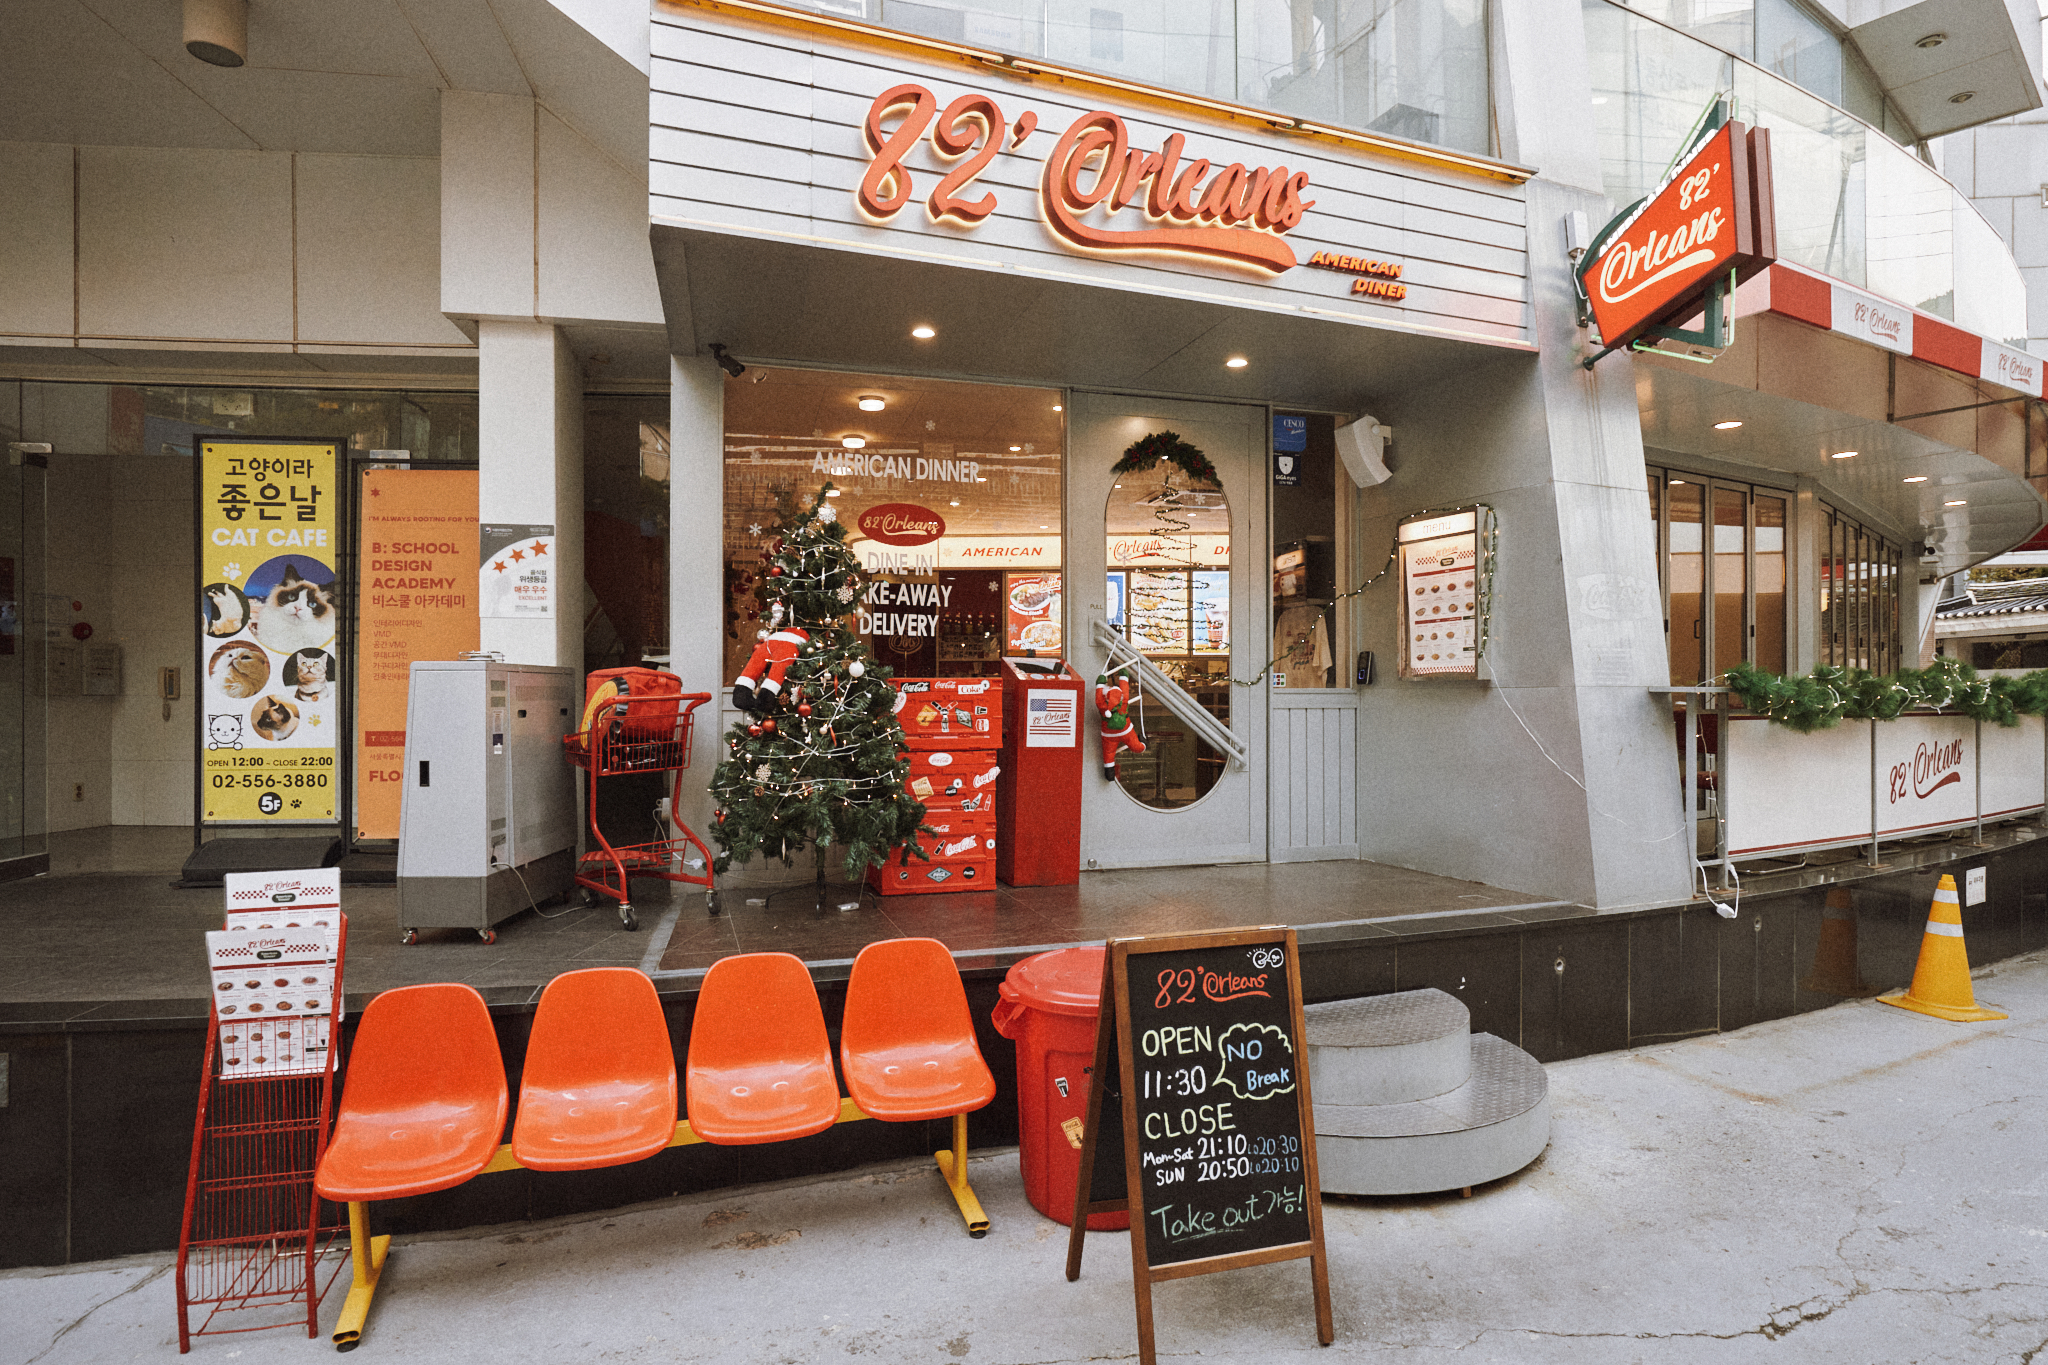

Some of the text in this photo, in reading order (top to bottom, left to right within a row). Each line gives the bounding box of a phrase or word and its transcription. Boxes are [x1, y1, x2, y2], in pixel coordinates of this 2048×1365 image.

[860, 83, 1317, 274] 82' Orleans
[1679, 163, 1720, 210] 82'
[1310, 251, 1403, 280] AMERICAN
[1600, 207, 1725, 303] Orleans
[1351, 278, 1407, 301] DINER
[1854, 302, 1901, 342] 82' Orleans
[1999, 353, 2033, 385] 82' Orleans
[1283, 419, 1305, 428] CESCO
[225, 457, 314, 481] 고양이라
[812, 451, 980, 484] AMERICAN DINNER
[217, 483, 321, 522] 좋은날
[863, 513, 940, 536] 82' Orleans
[1423, 520, 1451, 534] menu
[211, 528, 327, 547] CAT CAFE
[391, 543, 459, 554] SCHOOL
[962, 547, 1042, 557] AMERICAN
[1113, 540, 1162, 561] Orleans
[372, 560, 432, 571] DESIGN
[867, 551, 933, 577] DINE-IN
[372, 578, 456, 589] ACADEMY
[514, 586, 547, 594] 매우 우수
[860, 582, 952, 607] KE-AWAY
[372, 594, 465, 608] 비스쿨 아카데미
[373, 630, 392, 638] VMD
[860, 612, 939, 637] DELIVERY
[389, 641, 407, 649] VMD
[961, 685, 981, 693] Coke
[1044, 713, 1070, 725] Orleans
[207, 759, 229, 767] OPEN
[232, 757, 264, 767] 12:00
[273, 759, 298, 767] CLOSE
[301, 756, 333, 766] 22:00
[1889, 737, 1964, 805] 82' Orleans
[212, 774, 328, 788] 02-556-3880
[369, 770, 404, 782] FLO
[260, 796, 281, 812] 5F
[276, 881, 301, 892] Orleans
[259, 939, 286, 949] Orleans
[1155, 966, 1271, 1008] 82' Orleans
[1142, 1025, 1213, 1056] OPEN
[1227, 1039, 1263, 1062] NO
[1144, 1065, 1207, 1099] 11:30
[1246, 1067, 1290, 1091] Break
[1144, 1102, 1236, 1140] CLOSE
[1197, 1134, 1247, 1159] 21:10
[1257, 1135, 1298, 1155] 20:30
[1156, 1166, 1185, 1186] SUN
[1197, 1156, 1250, 1182] 20:50
[1261, 1157, 1299, 1174] 20:10
[1150, 1183, 1304, 1240] Take out 가능!
